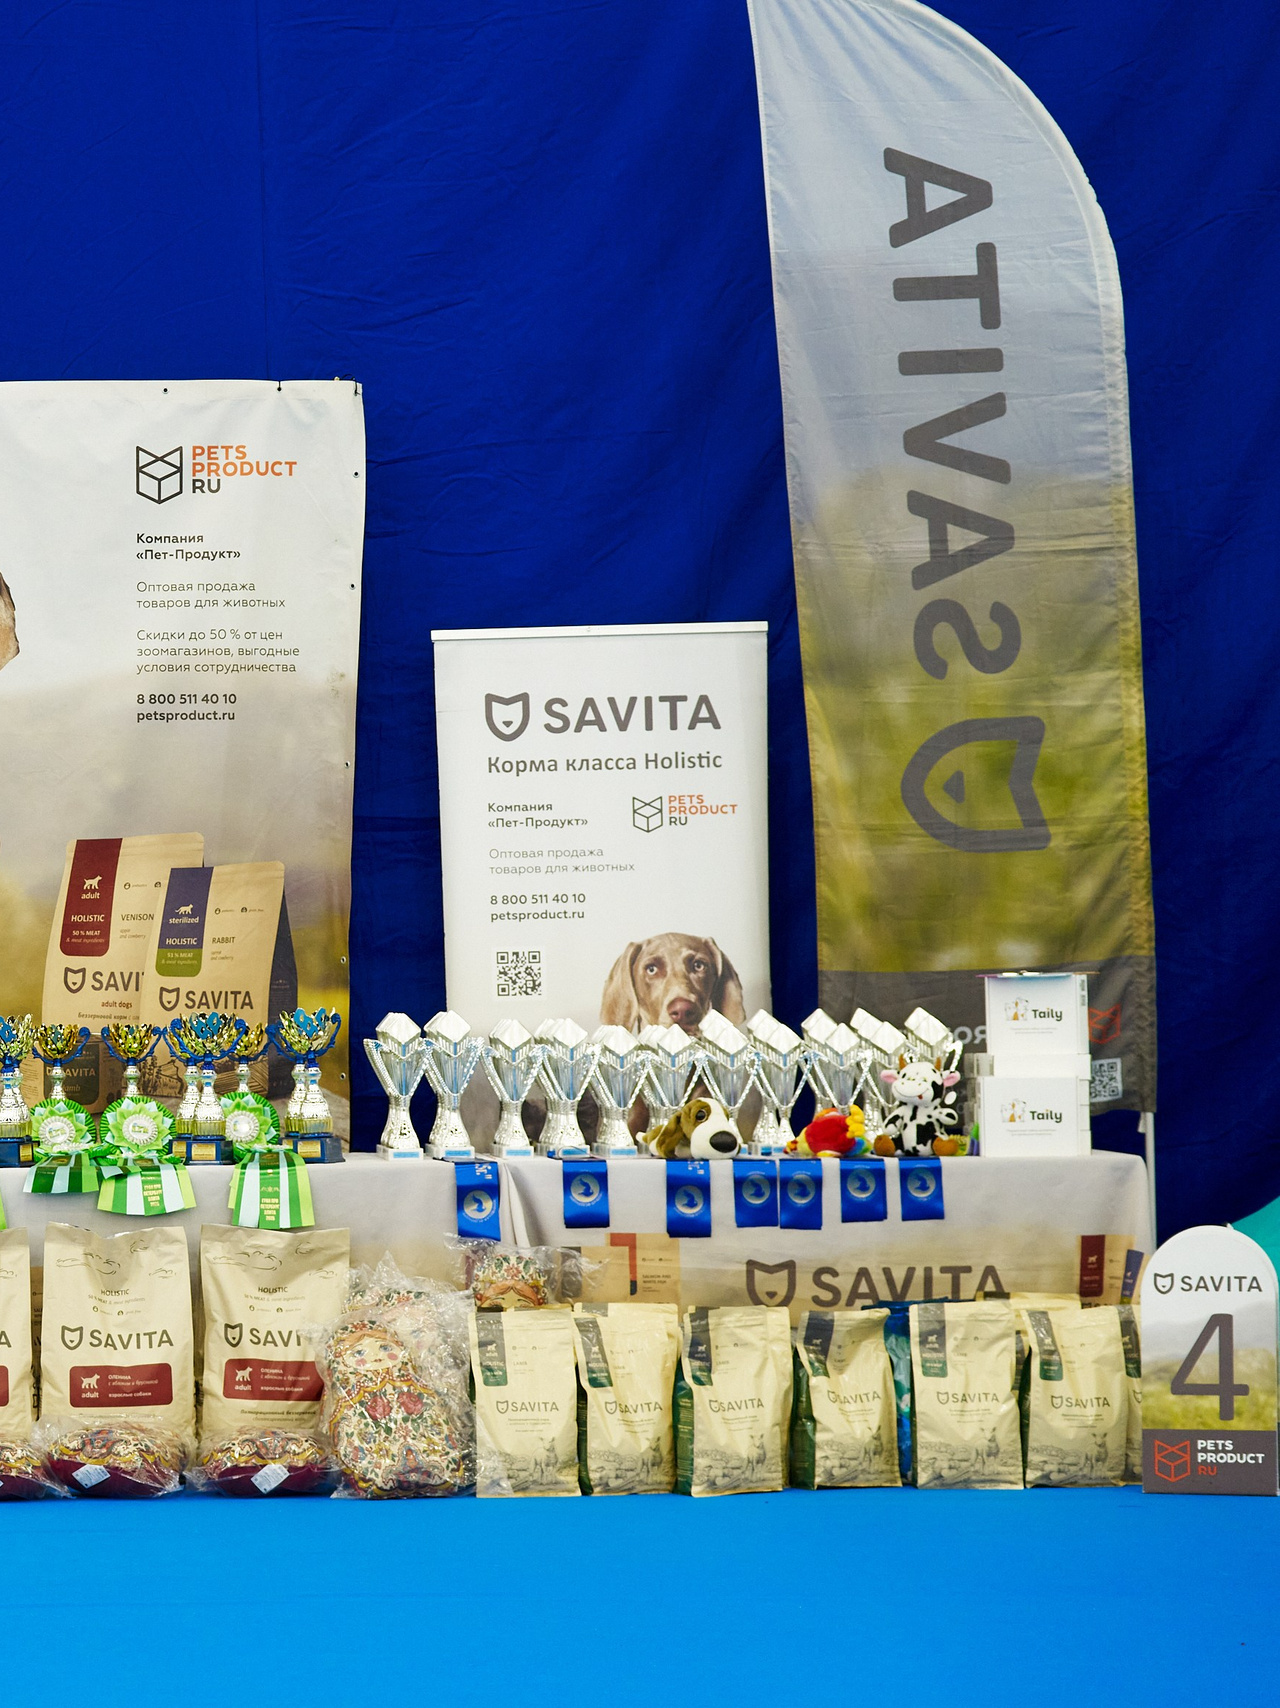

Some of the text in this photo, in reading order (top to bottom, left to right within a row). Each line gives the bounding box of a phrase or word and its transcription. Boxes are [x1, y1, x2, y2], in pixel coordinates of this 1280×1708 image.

[192, 445, 247, 461] PETS
[192, 461, 298, 477] PRODUCT
[192, 478, 221, 494] RU
[136, 533, 204, 544] Компания
[136, 549, 241, 562] «Пет-Продукт»
[136, 581, 256, 593] Оптовая продажа
[136, 598, 286, 610] товаров для животных
[136, 629, 283, 642] Скидки до 50 % от цен
[136, 645, 300, 658] зоомагазинов, выгодные
[136, 662, 297, 675] условия сотрудничества
[136, 694, 237, 705] 8 800 511 40 10
[136, 710, 235, 723] petsproduct.ru
[543, 694, 722, 734] SAVITA
[487, 751, 723, 777] Корма класса Holistic
[668, 794, 704, 805] PETS
[487, 801, 553, 813] Компания
[668, 804, 738, 816] PRODUCT
[487, 816, 588, 829] «Пет-Продукт»
[669, 816, 688, 826] RU
[489, 847, 604, 859] Оптовая продажа
[489, 862, 635, 876] товаров для животных
[81, 892, 100, 900] adult
[490, 893, 586, 905] 8 800 511 40 10
[71, 914, 105, 922] HOLISTIC
[491, 909, 585, 923] petsproduct.ru
[166, 937, 197, 945] HOLISTIC
[91, 971, 144, 992] SAVI
[119, 1001, 132, 1009] dogs
[184, 990, 254, 1010] SAVITA
[1031, 1007, 1063, 1022] Taily
[65, 1068, 96, 1077] AVITA
[1029, 1109, 1063, 1124] Taily
[811, 1265, 1005, 1308] SAVITA
[1180, 1275, 1263, 1292] SAVITA
[89, 1329, 174, 1350] SAVITA
[1171, 1313, 1250, 1421] 4
[951, 1392, 999, 1403] SAVITA
[1065, 1397, 1110, 1408] SAVITA
[511, 1401, 559, 1412] SAVITA
[618, 1402, 663, 1414] SAVITA
[720, 1398, 764, 1412] SAVITA
[1197, 1439, 1233, 1450] PETS
[1197, 1453, 1265, 1464] PRODUCT
[1198, 1466, 1217, 1475] RU
